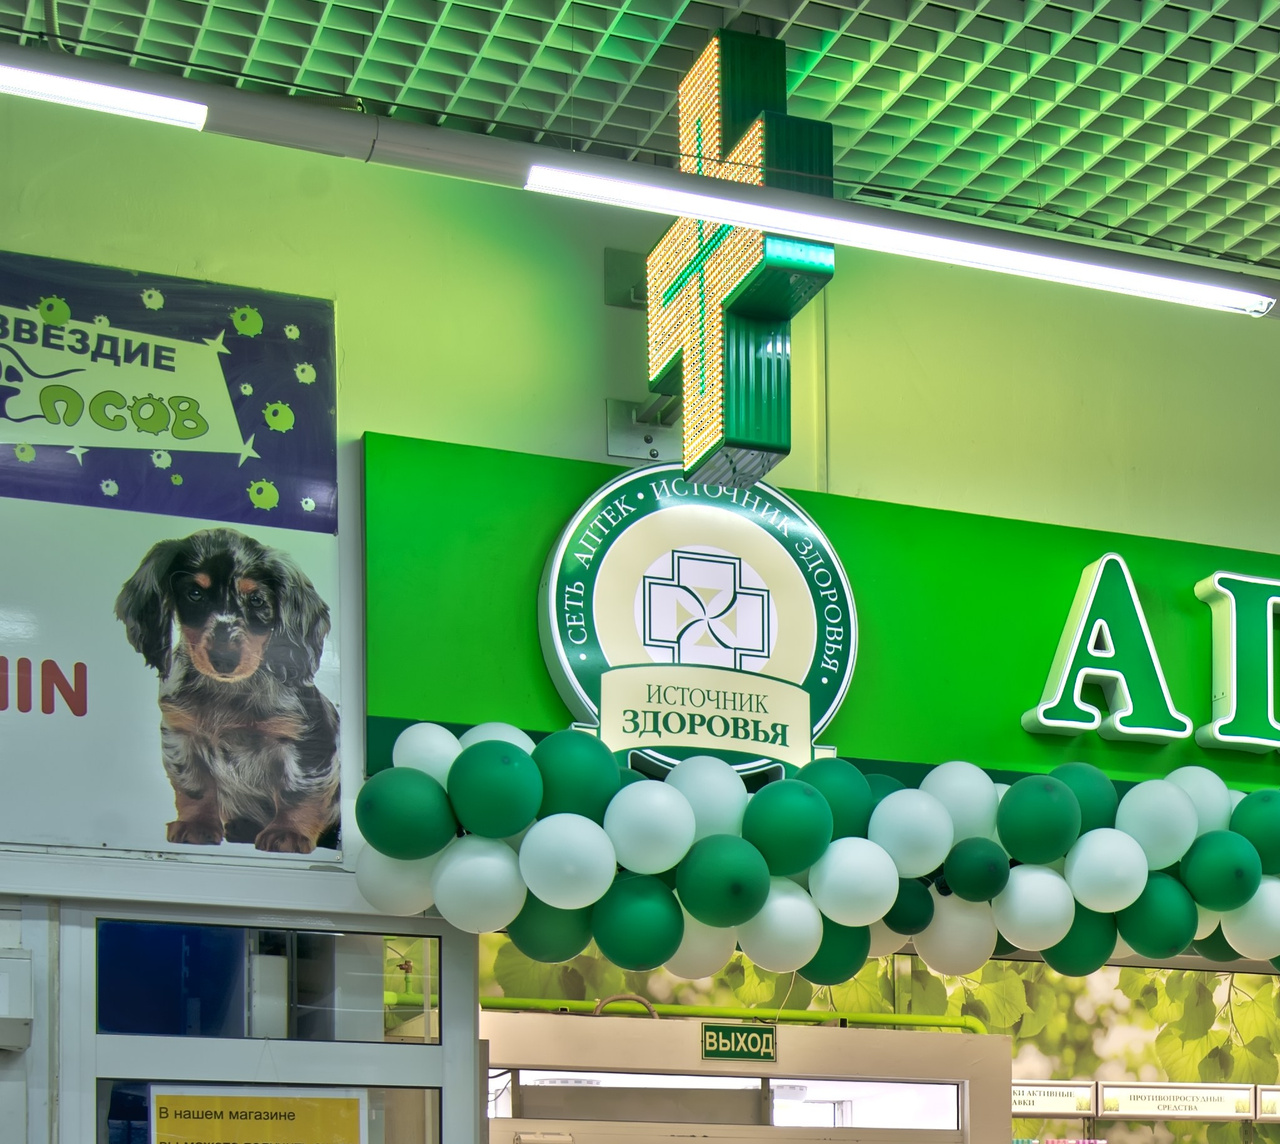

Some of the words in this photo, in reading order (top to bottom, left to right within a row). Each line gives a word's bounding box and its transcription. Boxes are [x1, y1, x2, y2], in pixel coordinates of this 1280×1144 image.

[573, 494, 637, 570] АПТЕК
[564, 580, 588, 645] СЕТЬ
[795, 537, 843, 674] ЗДОРОВЬЯ
[646, 684, 769, 715] ИСТОЧНИК
[622, 710, 789, 747] ЗДОРОВЬЯ
[705, 1031, 774, 1057] ВЫХОД
[1026, 1090, 1075, 1098] АКТИВНЫЕ
[1129, 1094, 1225, 1103] ПРОТИВОПРОСТУДНЫЕ
[159, 1106, 169, 1119] В
[174, 1109, 224, 1120] нашем
[229, 1110, 296, 1121] магазине
